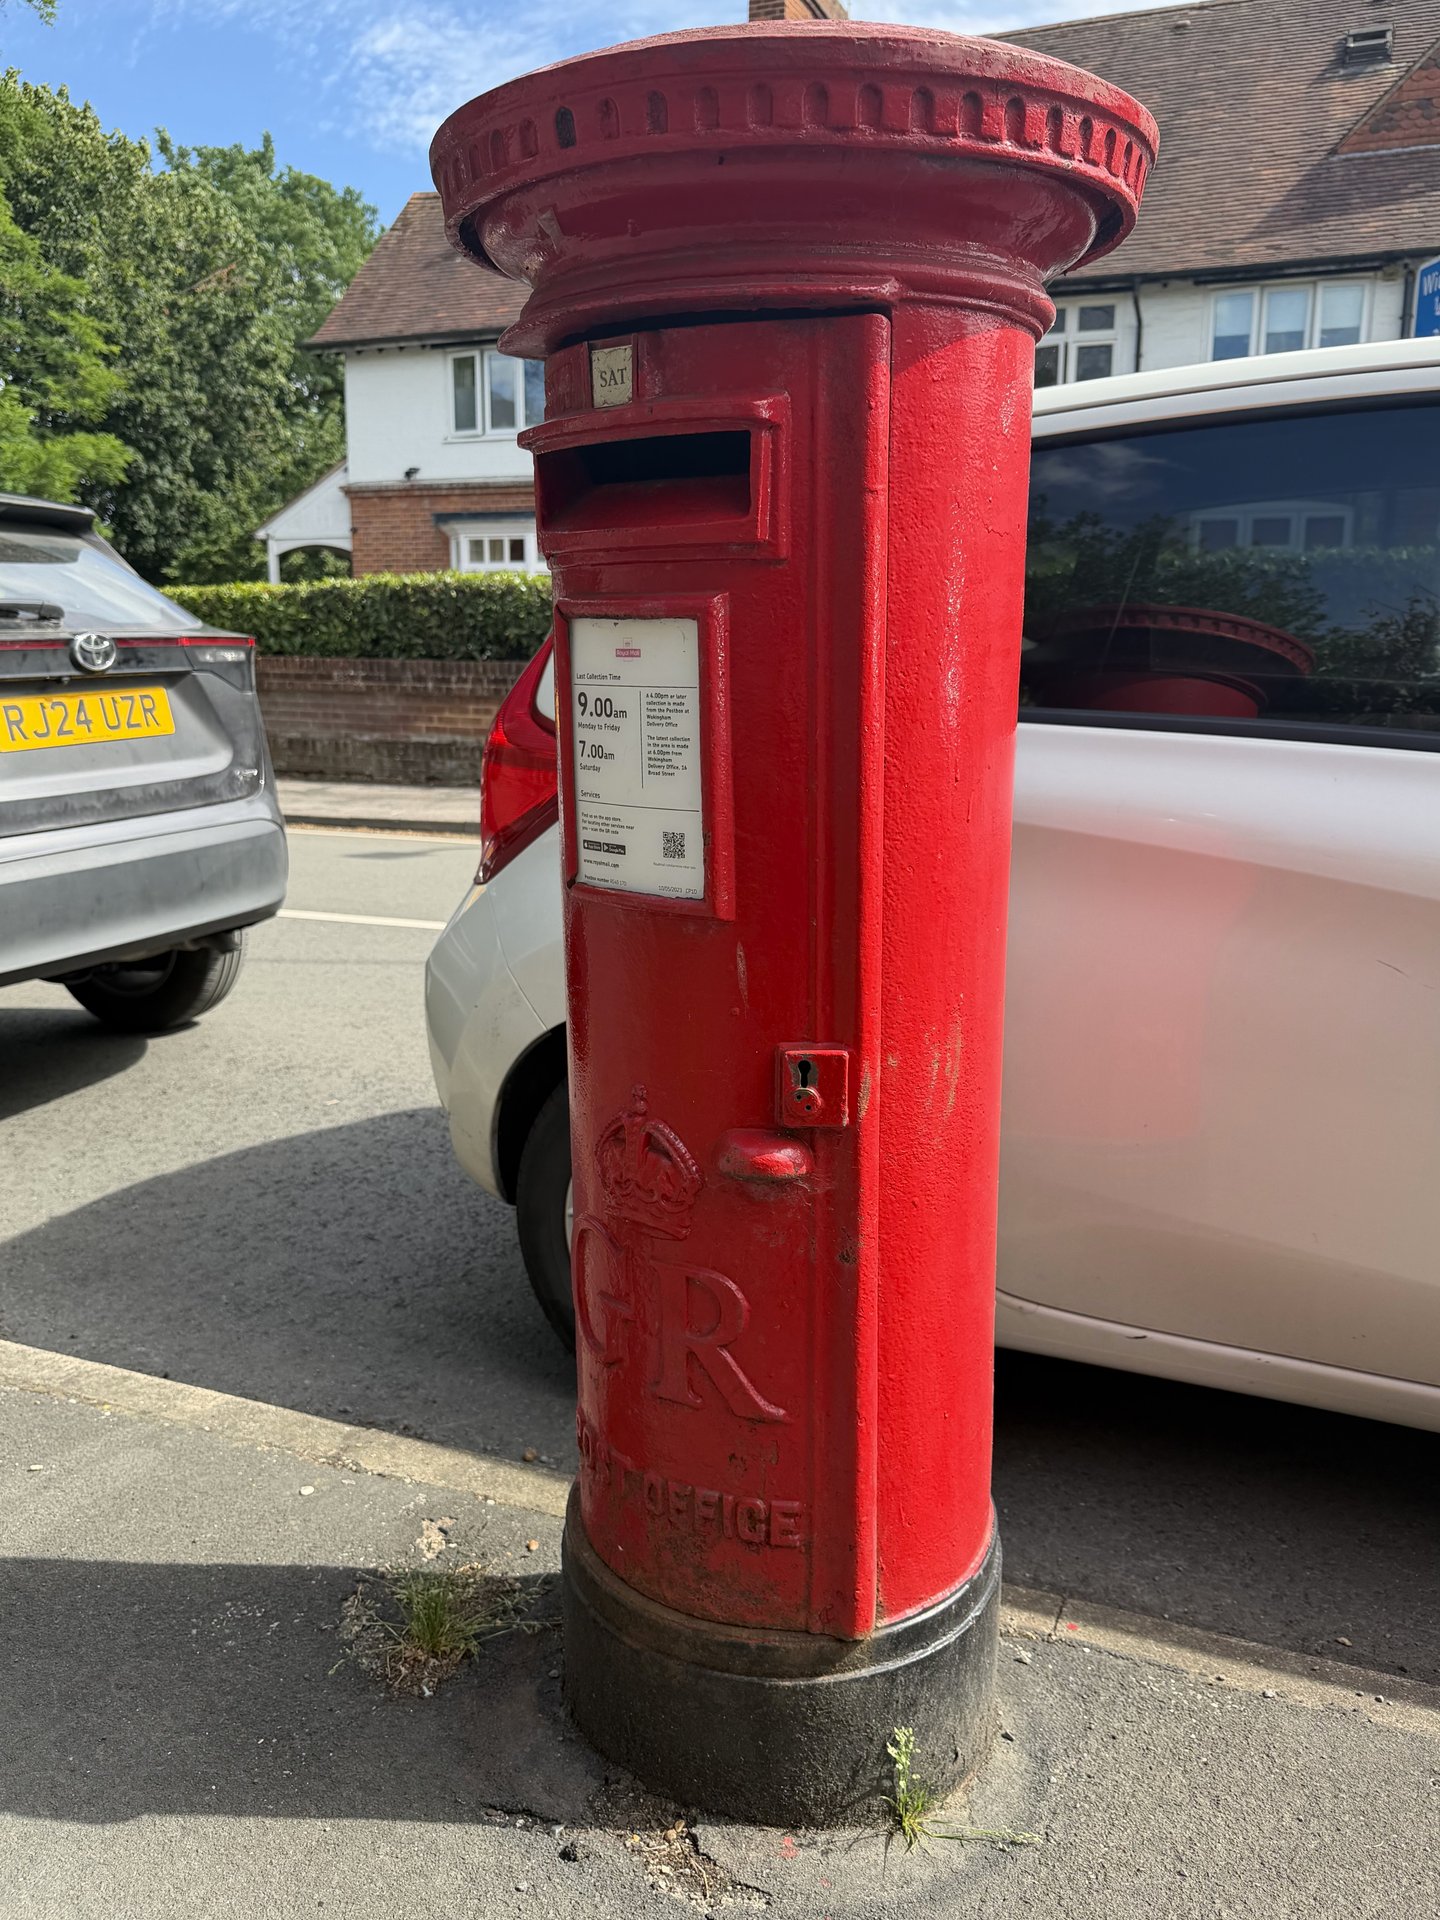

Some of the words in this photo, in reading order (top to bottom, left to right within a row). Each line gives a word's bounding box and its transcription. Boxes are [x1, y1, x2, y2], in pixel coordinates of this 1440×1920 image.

[600, 368, 627, 388] SAT
[578, 692, 628, 719] 9.00am
[650, 692, 668, 700] 4.00pm
[3, 700, 93, 742] RJ24
[100, 694, 160, 731] UZR
[578, 722, 596, 730] Monday
[604, 724, 620, 732] Friday
[579, 740, 615, 760] 7.00am
[580, 763, 601, 773] Saturday
[580, 790, 601, 799] Services
[573, 1215, 793, 1424] GR
